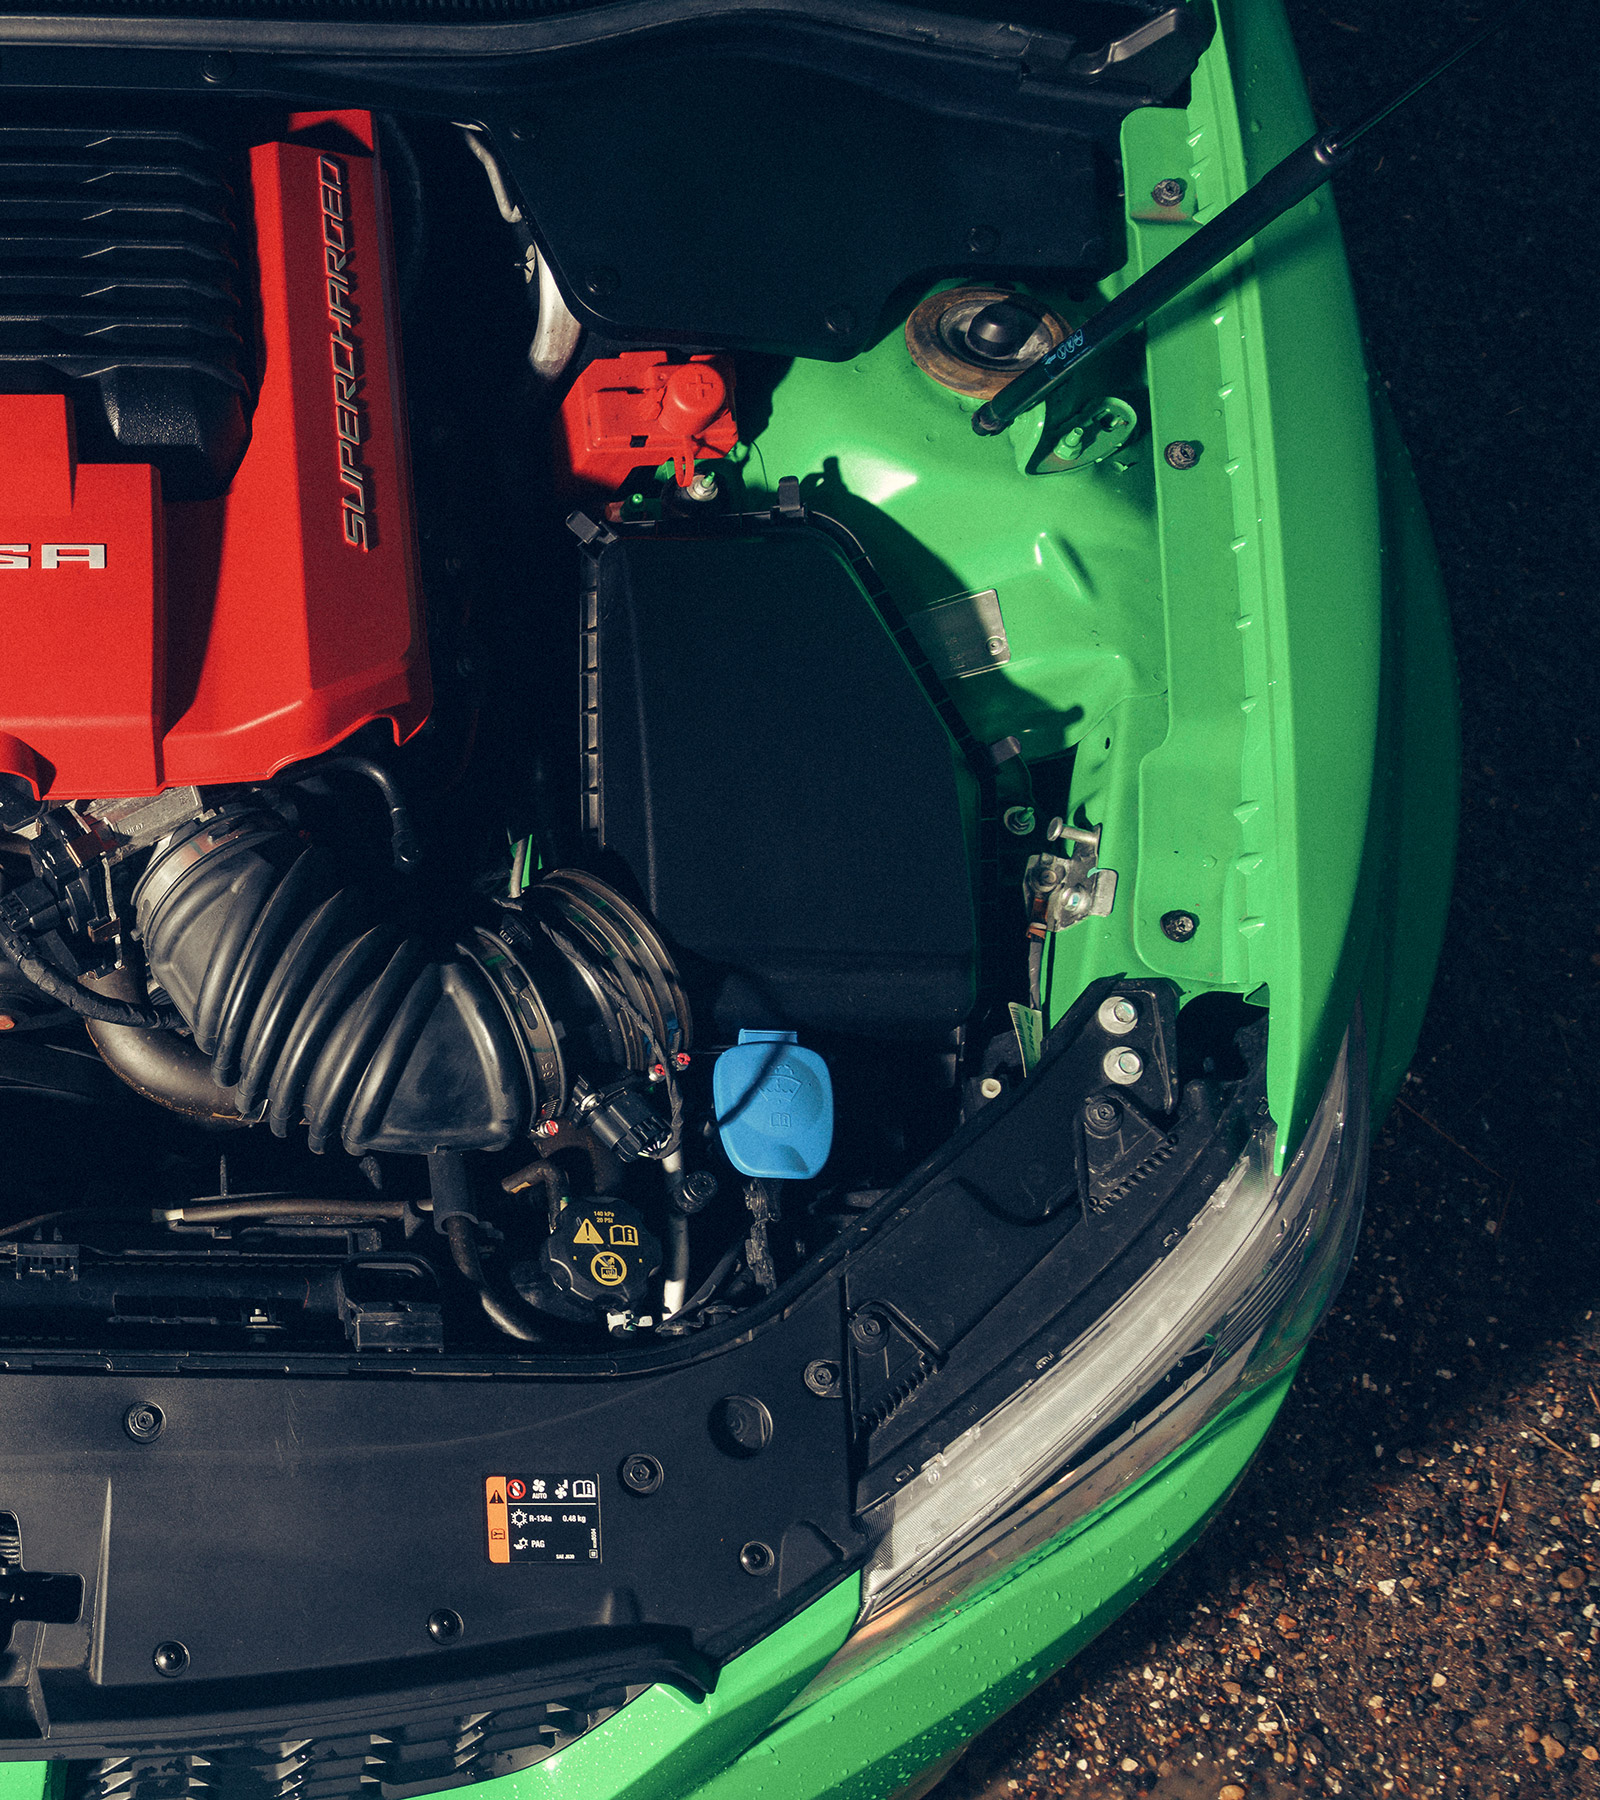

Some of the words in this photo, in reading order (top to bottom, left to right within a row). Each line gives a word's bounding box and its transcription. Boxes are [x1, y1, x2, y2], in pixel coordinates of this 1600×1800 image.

[318, 155, 369, 553] SUPERCHARGED
[531, 1492, 548, 1500] AUTO
[528, 1514, 553, 1523] R-134a
[562, 1514, 577, 1523] 0.48
[577, 1514, 587, 1524] kg
[530, 1540, 546, 1549] PAG
